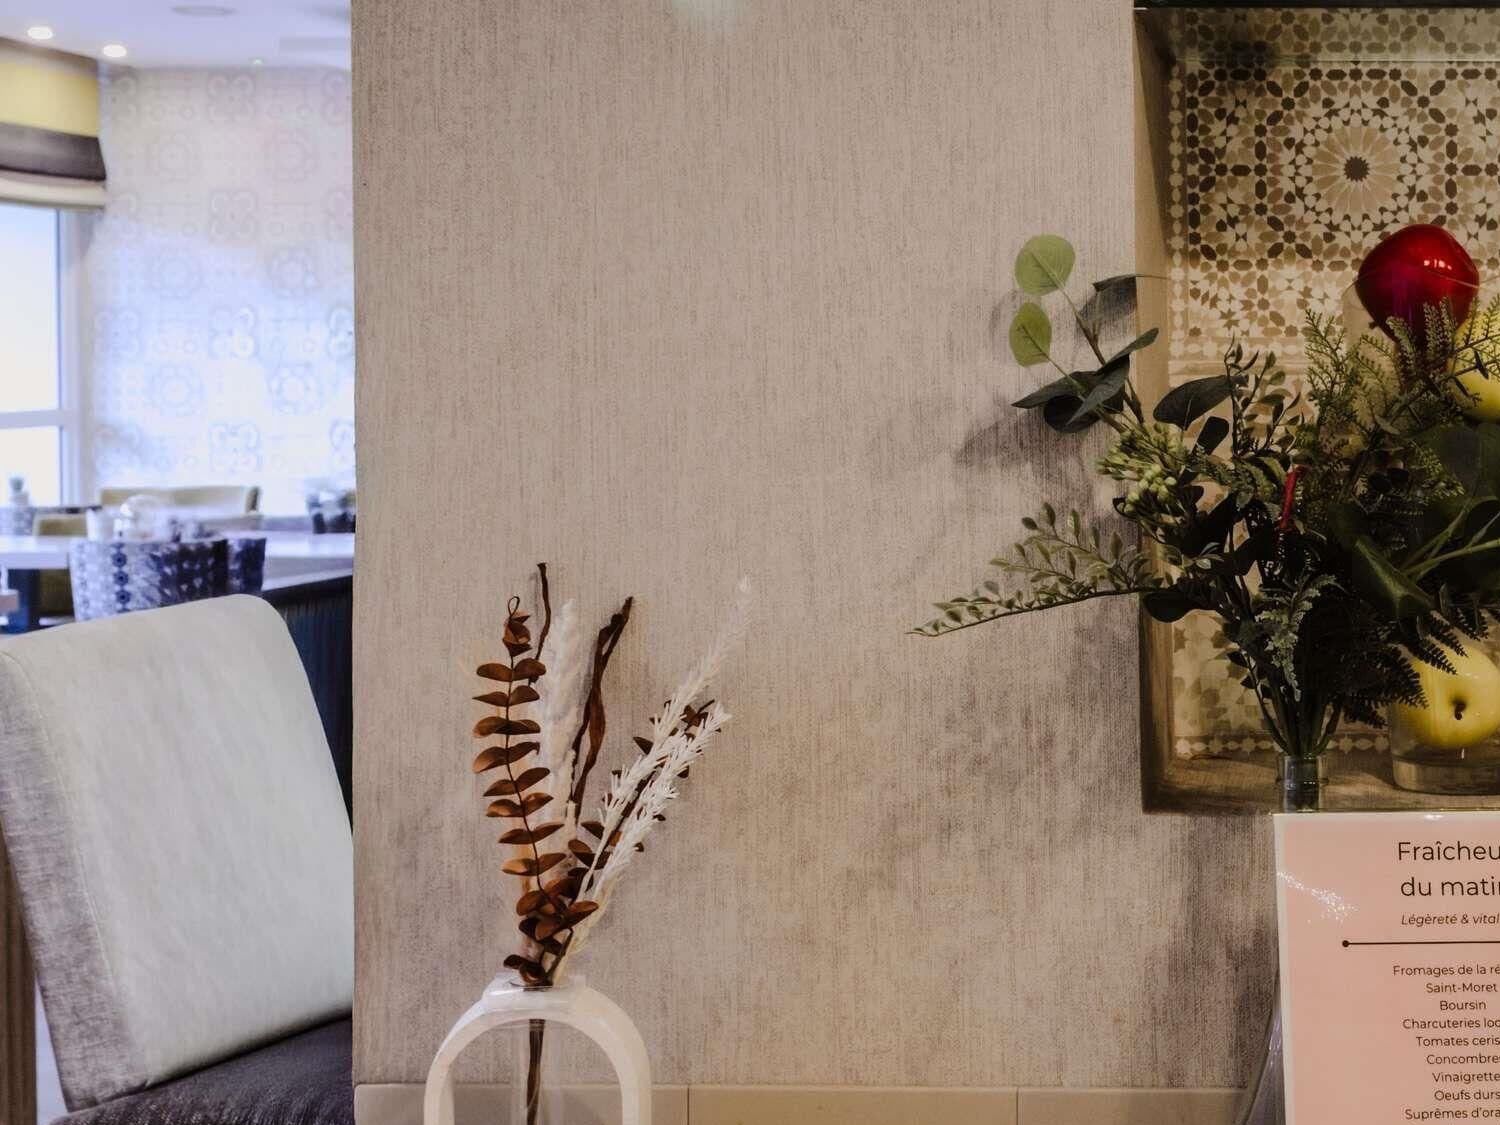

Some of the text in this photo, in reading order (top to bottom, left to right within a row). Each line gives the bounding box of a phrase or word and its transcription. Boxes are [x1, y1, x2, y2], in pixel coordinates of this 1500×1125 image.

[1400, 876, 1432, 897] du
[1401, 913, 1458, 928] Légèreté
[1460, 912, 1469, 925] &
[1393, 965, 1456, 978] Fromages
[1457, 964, 1474, 976] de
[1476, 963, 1488, 975] la
[1426, 982, 1498, 994] Saint-Moret
[1439, 1000, 1487, 1011] Boursin
[1402, 1016, 1481, 1029] Charcuteries
[1415, 1036, 1469, 1048] Tomates
[1432, 1071, 1500, 1085] Vinaigrette
[1434, 1089, 1471, 1102] Oeufs
[1405, 1108, 1468, 1122] Suprêmes
